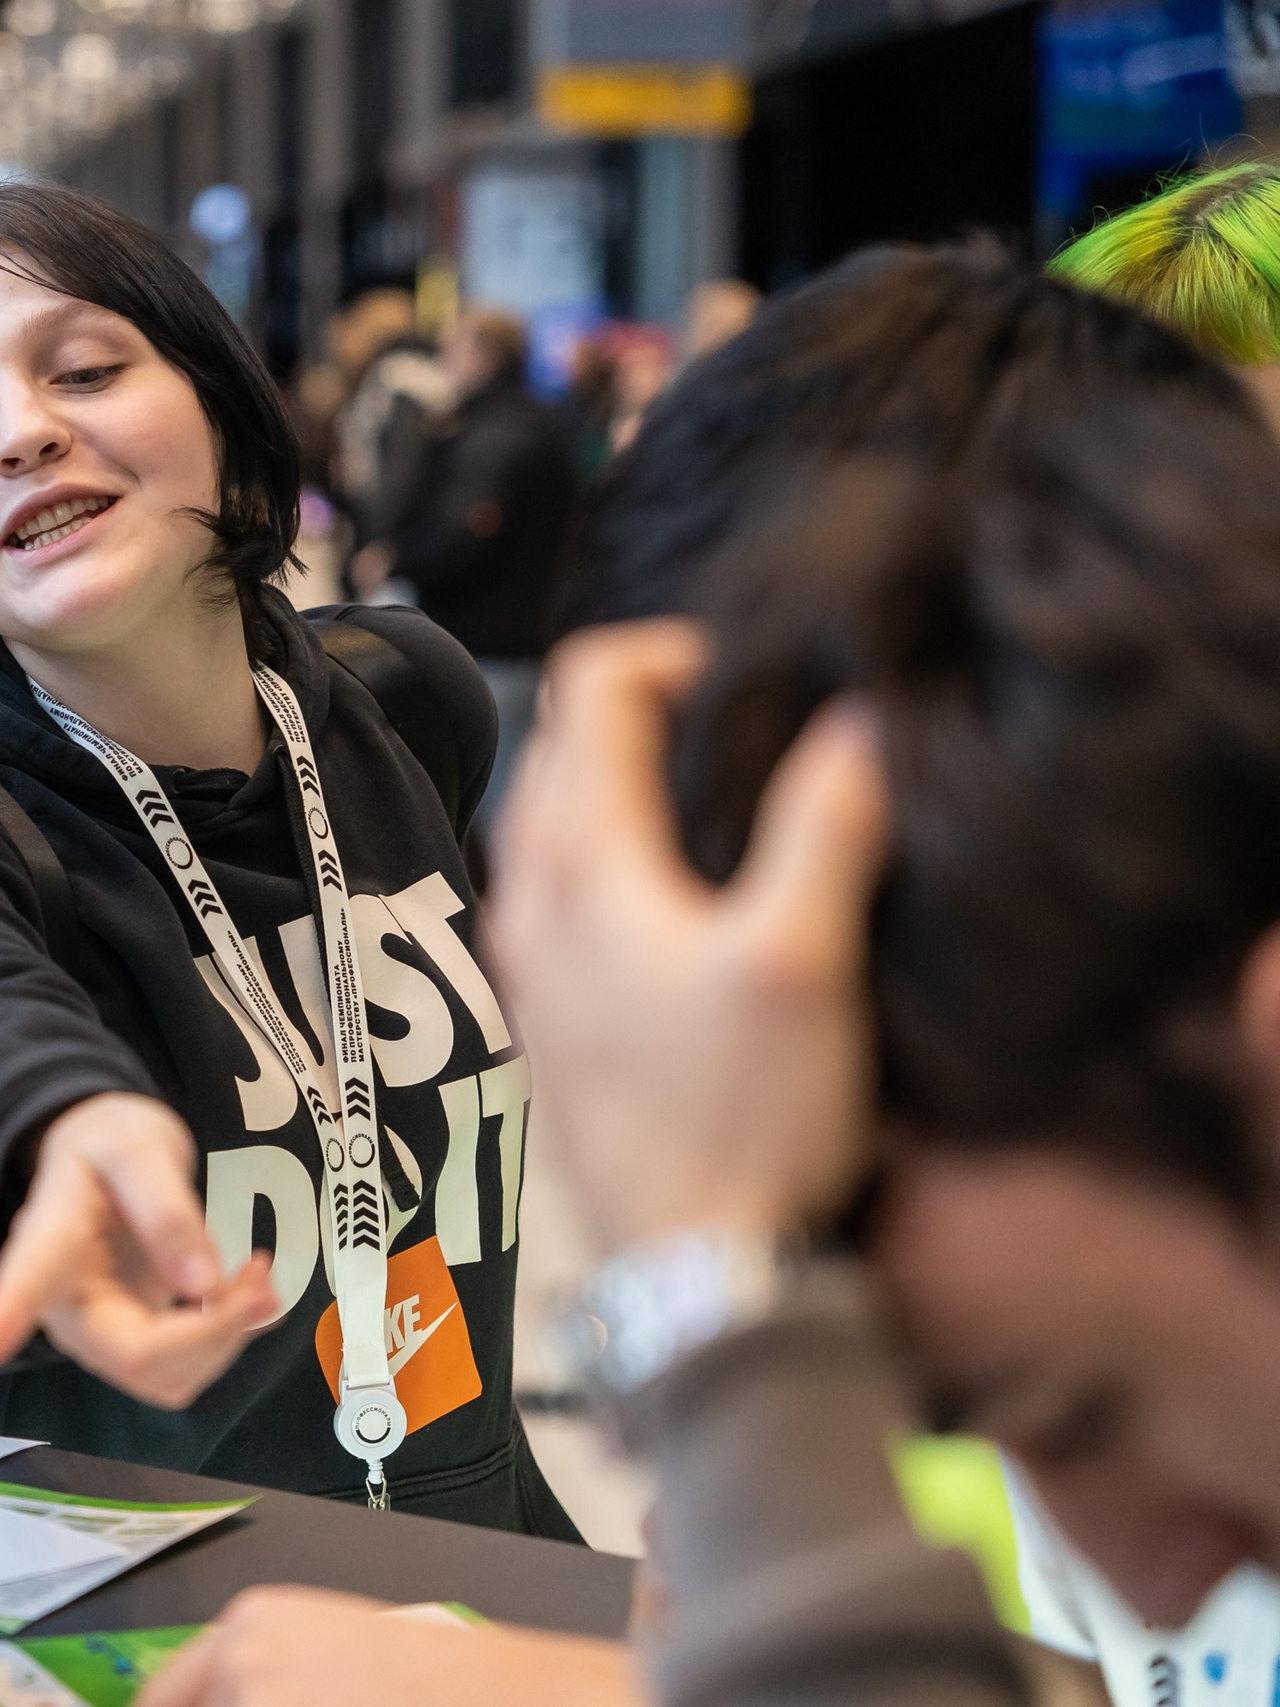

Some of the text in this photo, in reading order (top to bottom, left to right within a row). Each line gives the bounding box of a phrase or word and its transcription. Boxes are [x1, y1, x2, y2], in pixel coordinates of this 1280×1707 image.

[279, 714, 295, 742] ФИНАЛ
[280, 692, 306, 743] МАСТЕРСТВУ
[294, 731, 301, 743] ПО
[63, 722, 129, 781] ФИНАЛ ЧЕМПИОНАТА
[125, 766, 137, 778] ПО
[236, 963, 297, 1060] ПРОФЕССИОНАЛЬНОМУ
[333, 964, 350, 1064] ФИНАЛ ЧЕМПИОНАТА
[337, 940, 358, 1063] ПО ПРОФЕССИОНАЛЬНОМУ
[340, 908, 365, 1063] МАСТЕРСТВУ «ПРОФЕССИОНАЛЫ»
[245, 986, 300, 1075] ФИНАЛ ЧЕМПИОНАТА
[274, 1015, 307, 1071] МАСТЕРСТВУ
[435, 1052, 533, 1267] IT
[384, 1294, 423, 1355] KE
